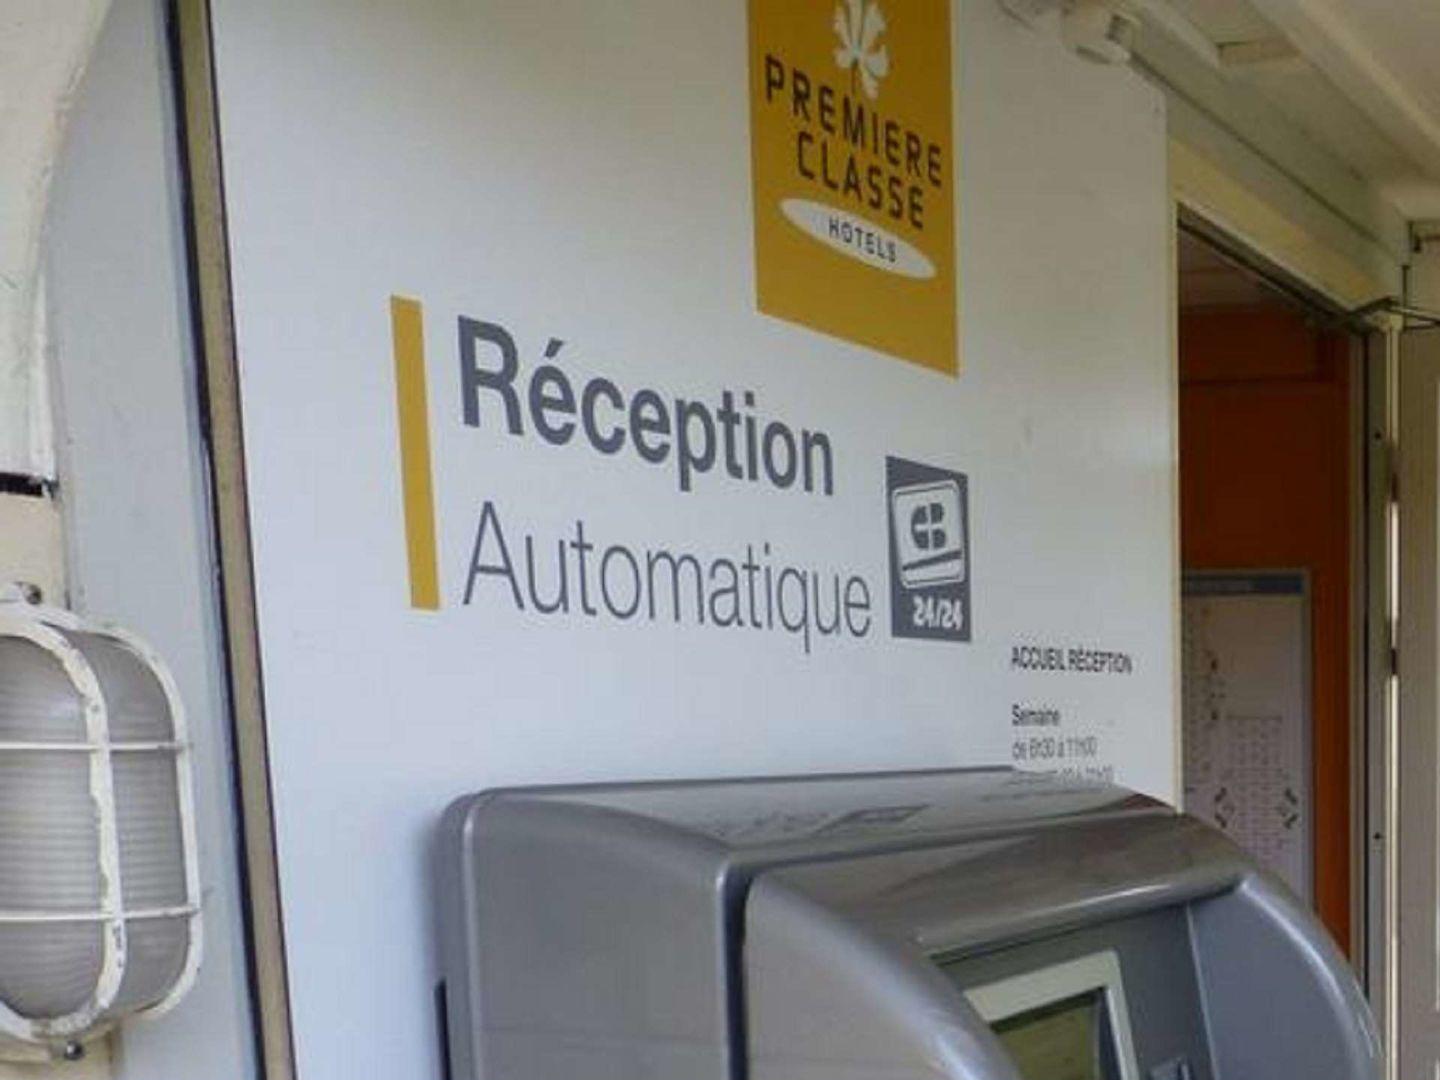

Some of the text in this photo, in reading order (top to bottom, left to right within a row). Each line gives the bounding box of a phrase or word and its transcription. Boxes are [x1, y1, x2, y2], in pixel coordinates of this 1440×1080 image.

[765, 54, 941, 188] PREMIERE
[797, 131, 923, 229] CLASSE
[829, 216, 896, 262] HOTELS
[457, 315, 833, 496] Réception
[463, 501, 870, 653] Automatique
[913, 596, 964, 631] 24/24
[1011, 646, 1065, 671] ACCUEIL
